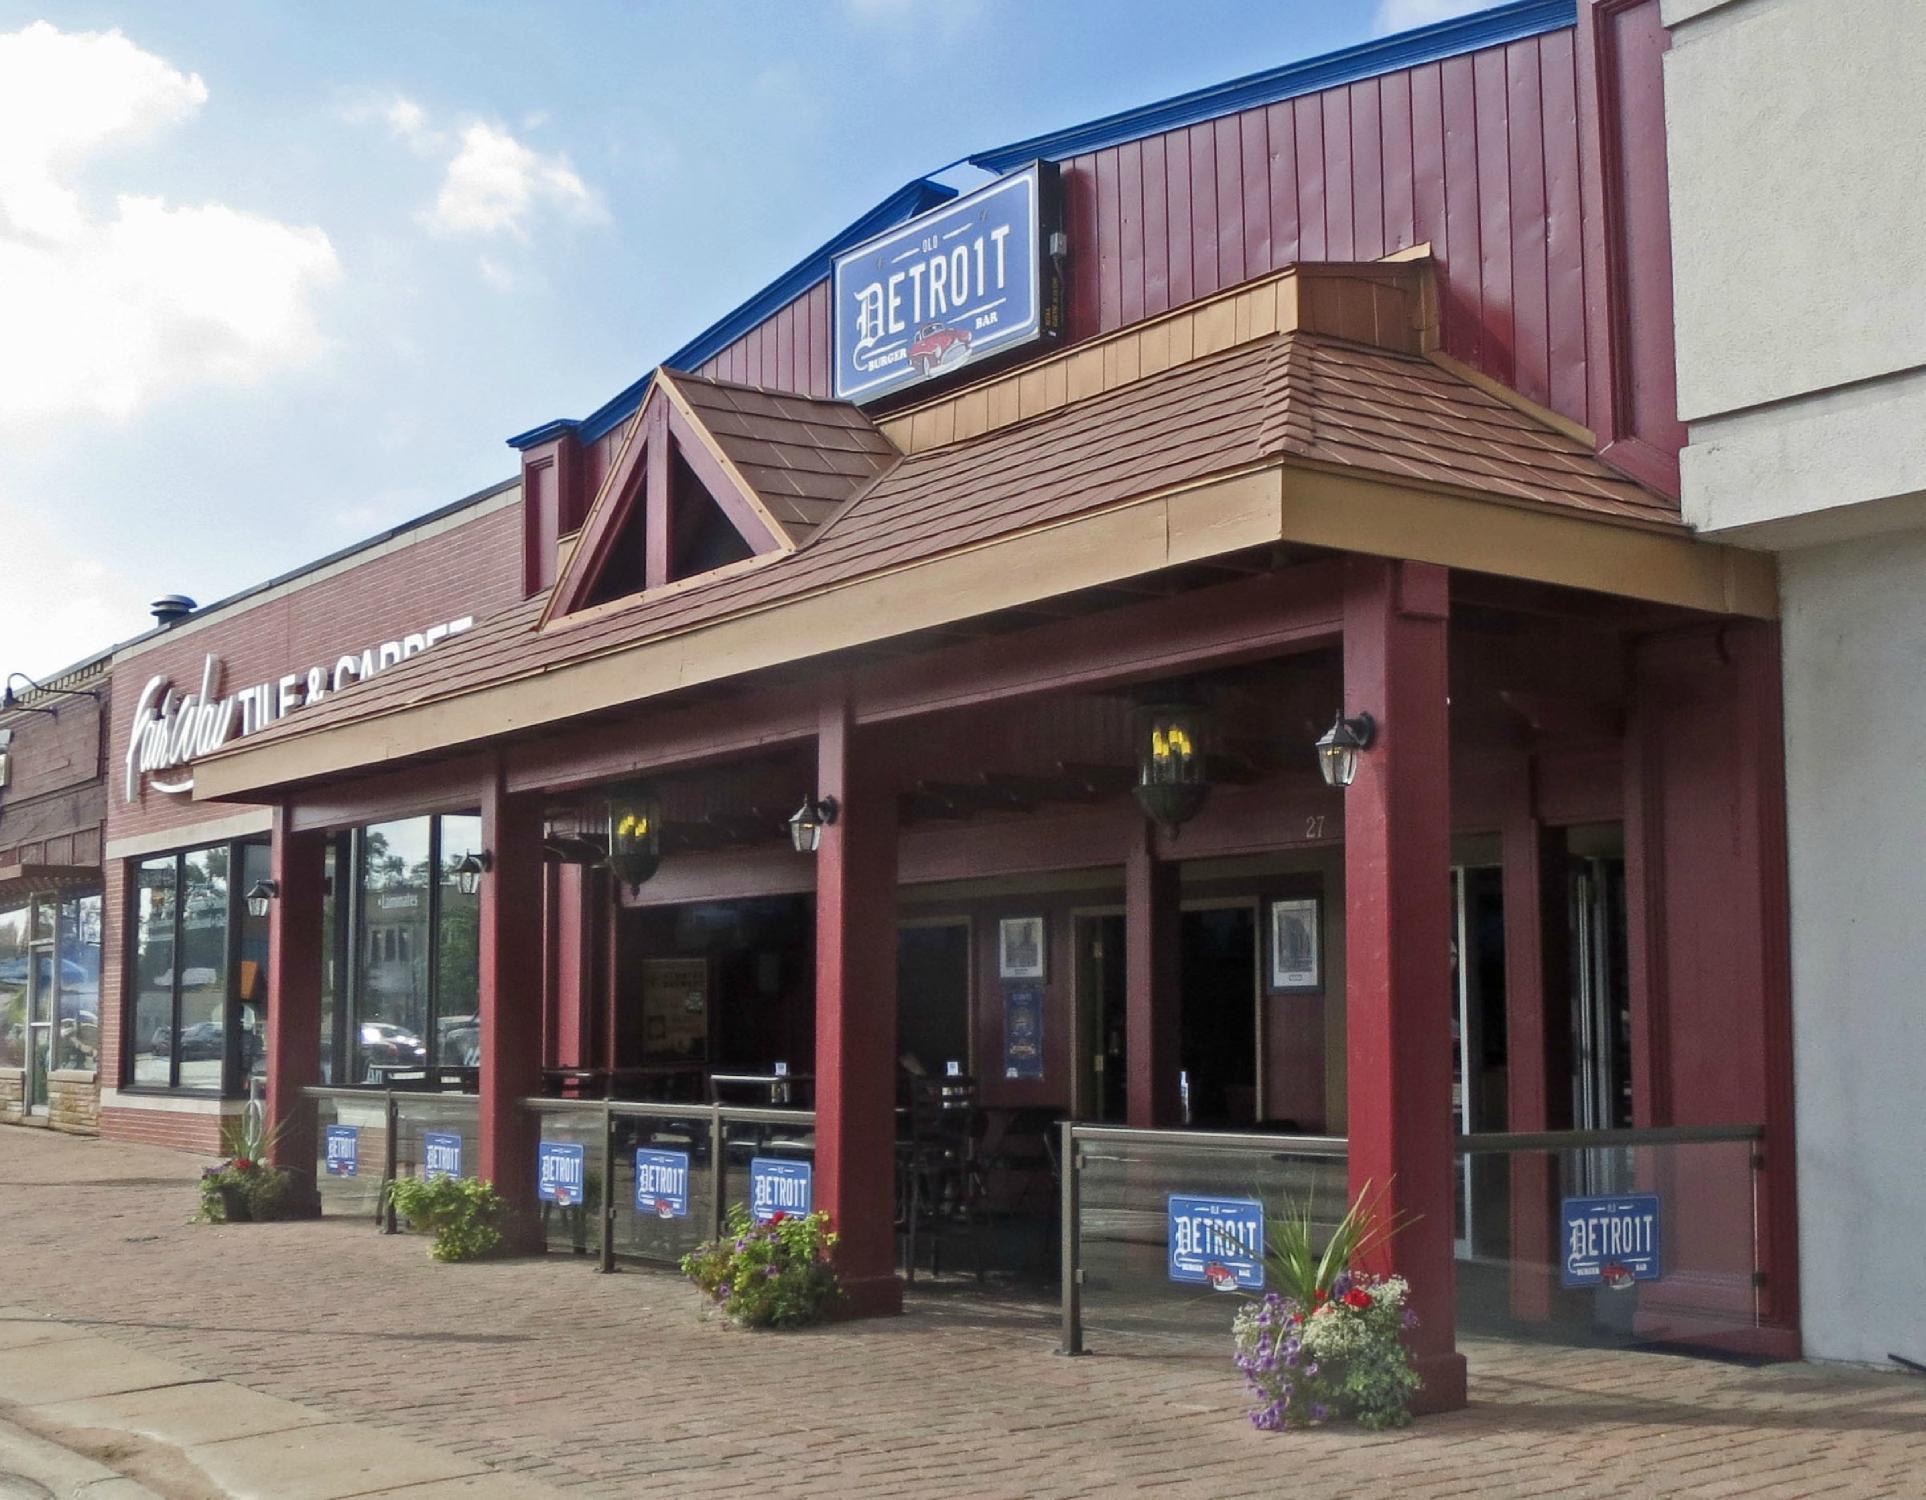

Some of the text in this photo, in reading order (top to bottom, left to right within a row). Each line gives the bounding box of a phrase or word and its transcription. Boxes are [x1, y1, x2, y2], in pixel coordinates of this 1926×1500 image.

[922, 235, 938, 253] OLD
[975, 311, 998, 329] BAR
[867, 348, 907, 372] BURGER
[1306, 815, 1325, 838] 27
